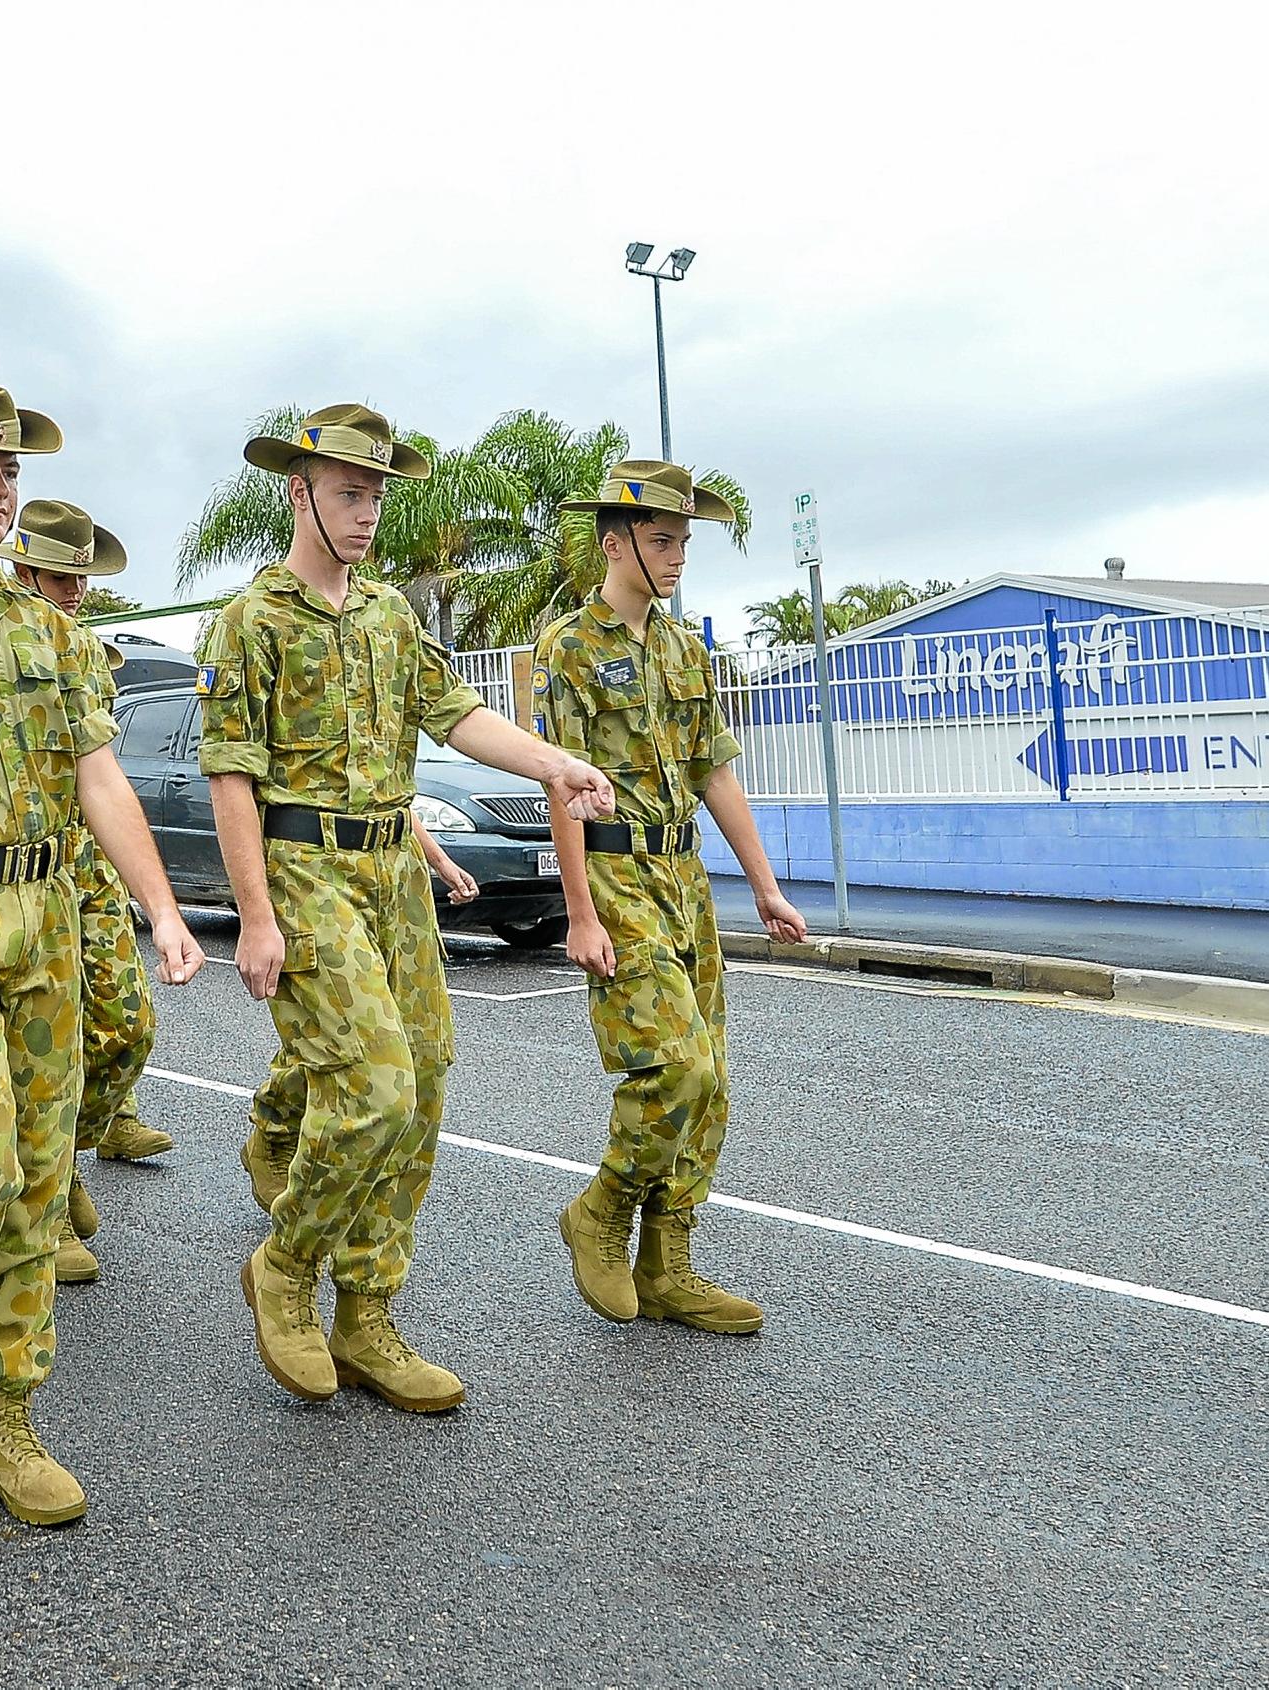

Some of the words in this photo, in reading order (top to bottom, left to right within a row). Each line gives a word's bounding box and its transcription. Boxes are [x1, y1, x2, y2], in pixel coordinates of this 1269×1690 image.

[795, 494, 811, 514] 1P
[902, 613, 1136, 695] Lincraft
[1204, 734, 1269, 770] EN
[540, 855, 559, 870] 066
